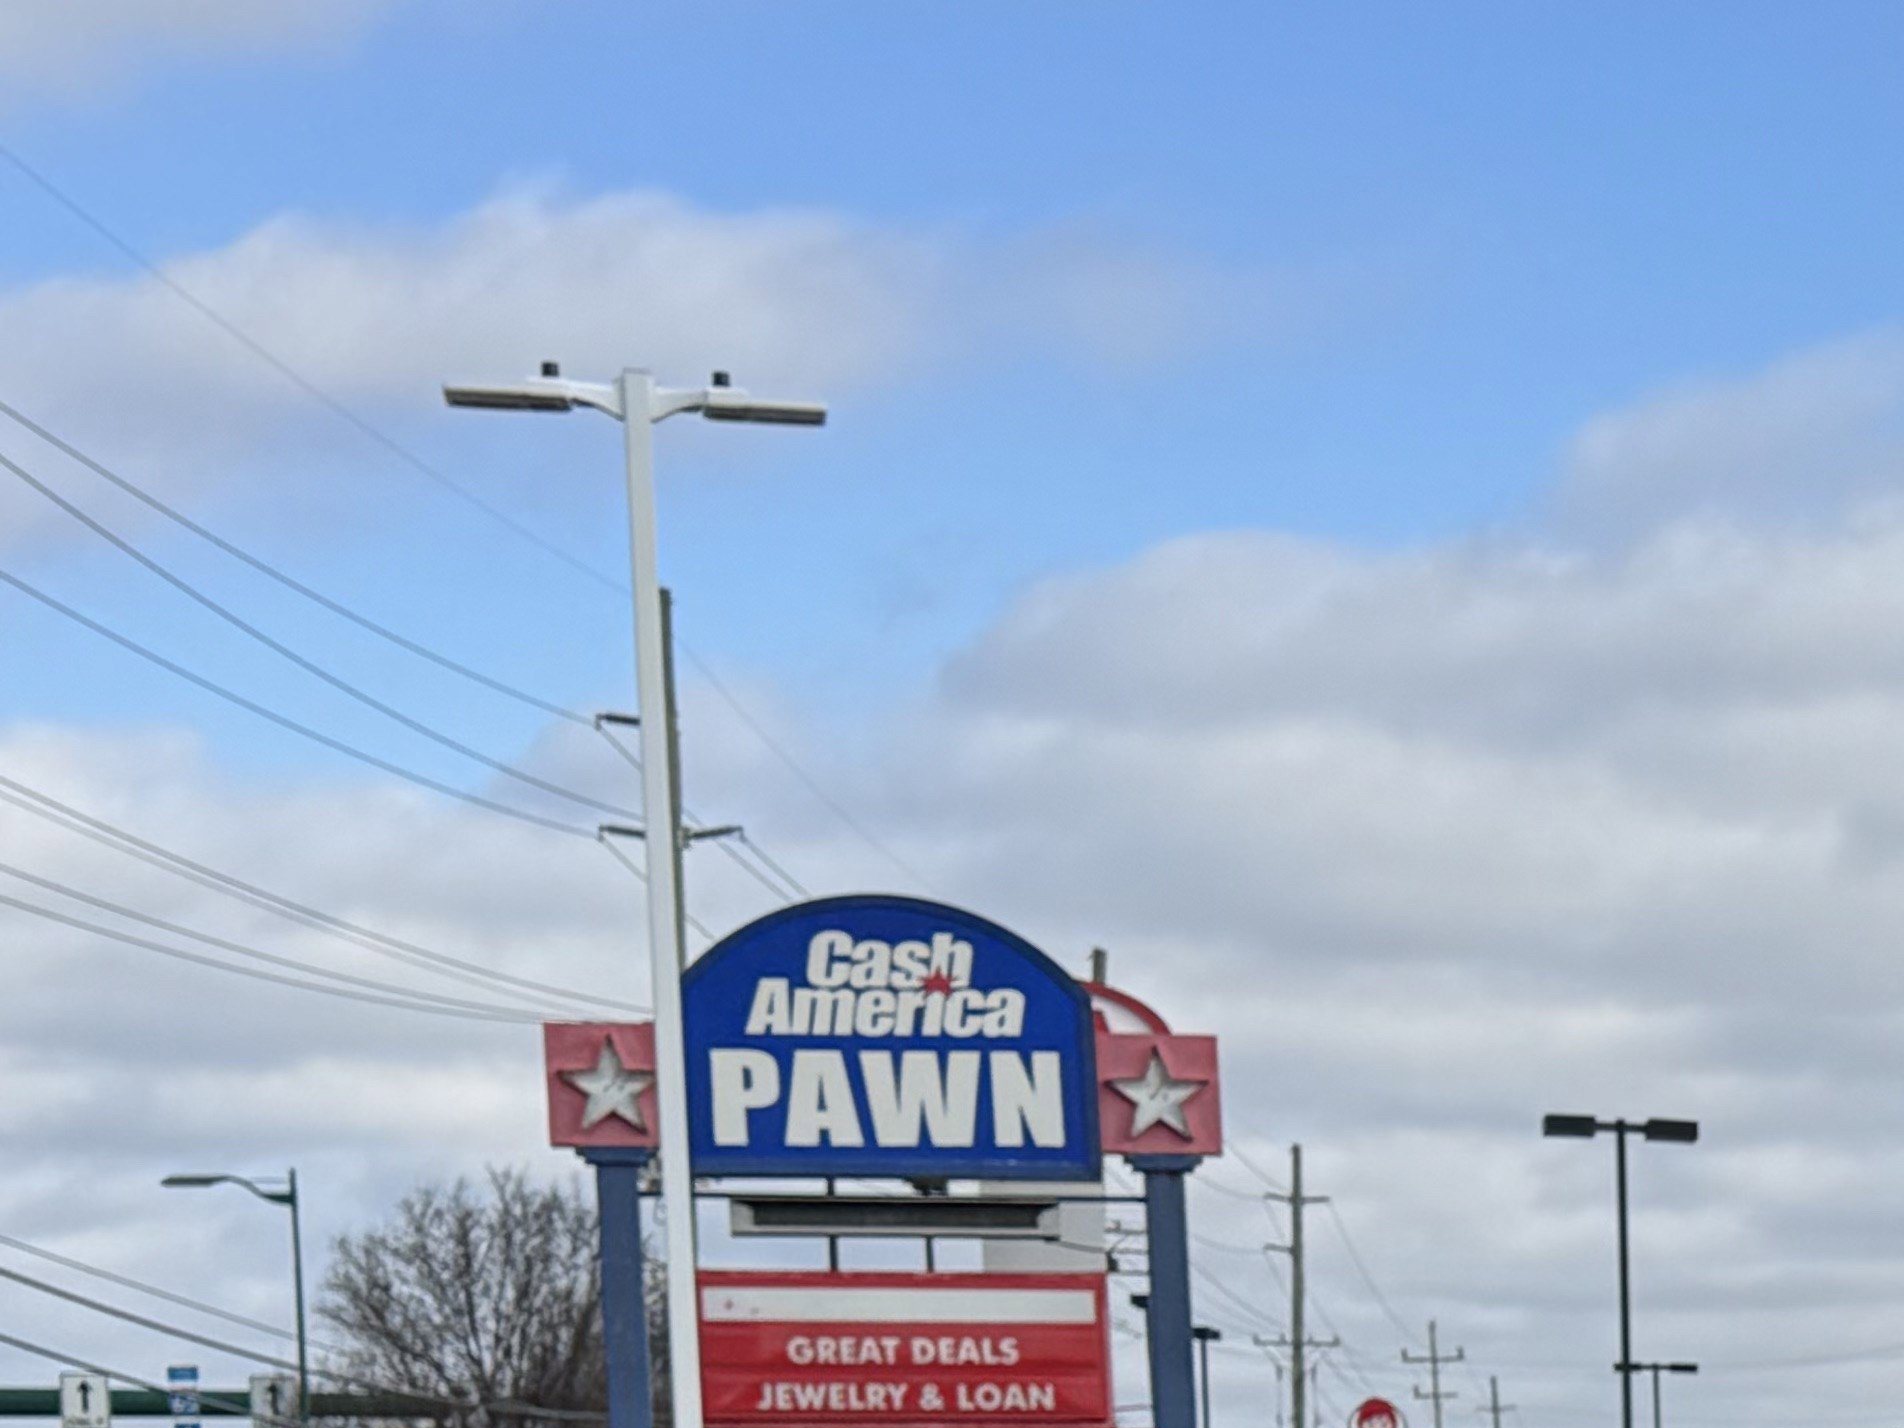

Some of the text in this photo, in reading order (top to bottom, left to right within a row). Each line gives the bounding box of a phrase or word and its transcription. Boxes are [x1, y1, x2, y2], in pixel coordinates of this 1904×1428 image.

[806, 929, 973, 989] Cash
[744, 977, 1026, 1038] America
[709, 1047, 1066, 1148] PAWN
[786, 1336, 1021, 1366] GREAT DEALS
[756, 1382, 1056, 1412] JEWELRY & LOAN
